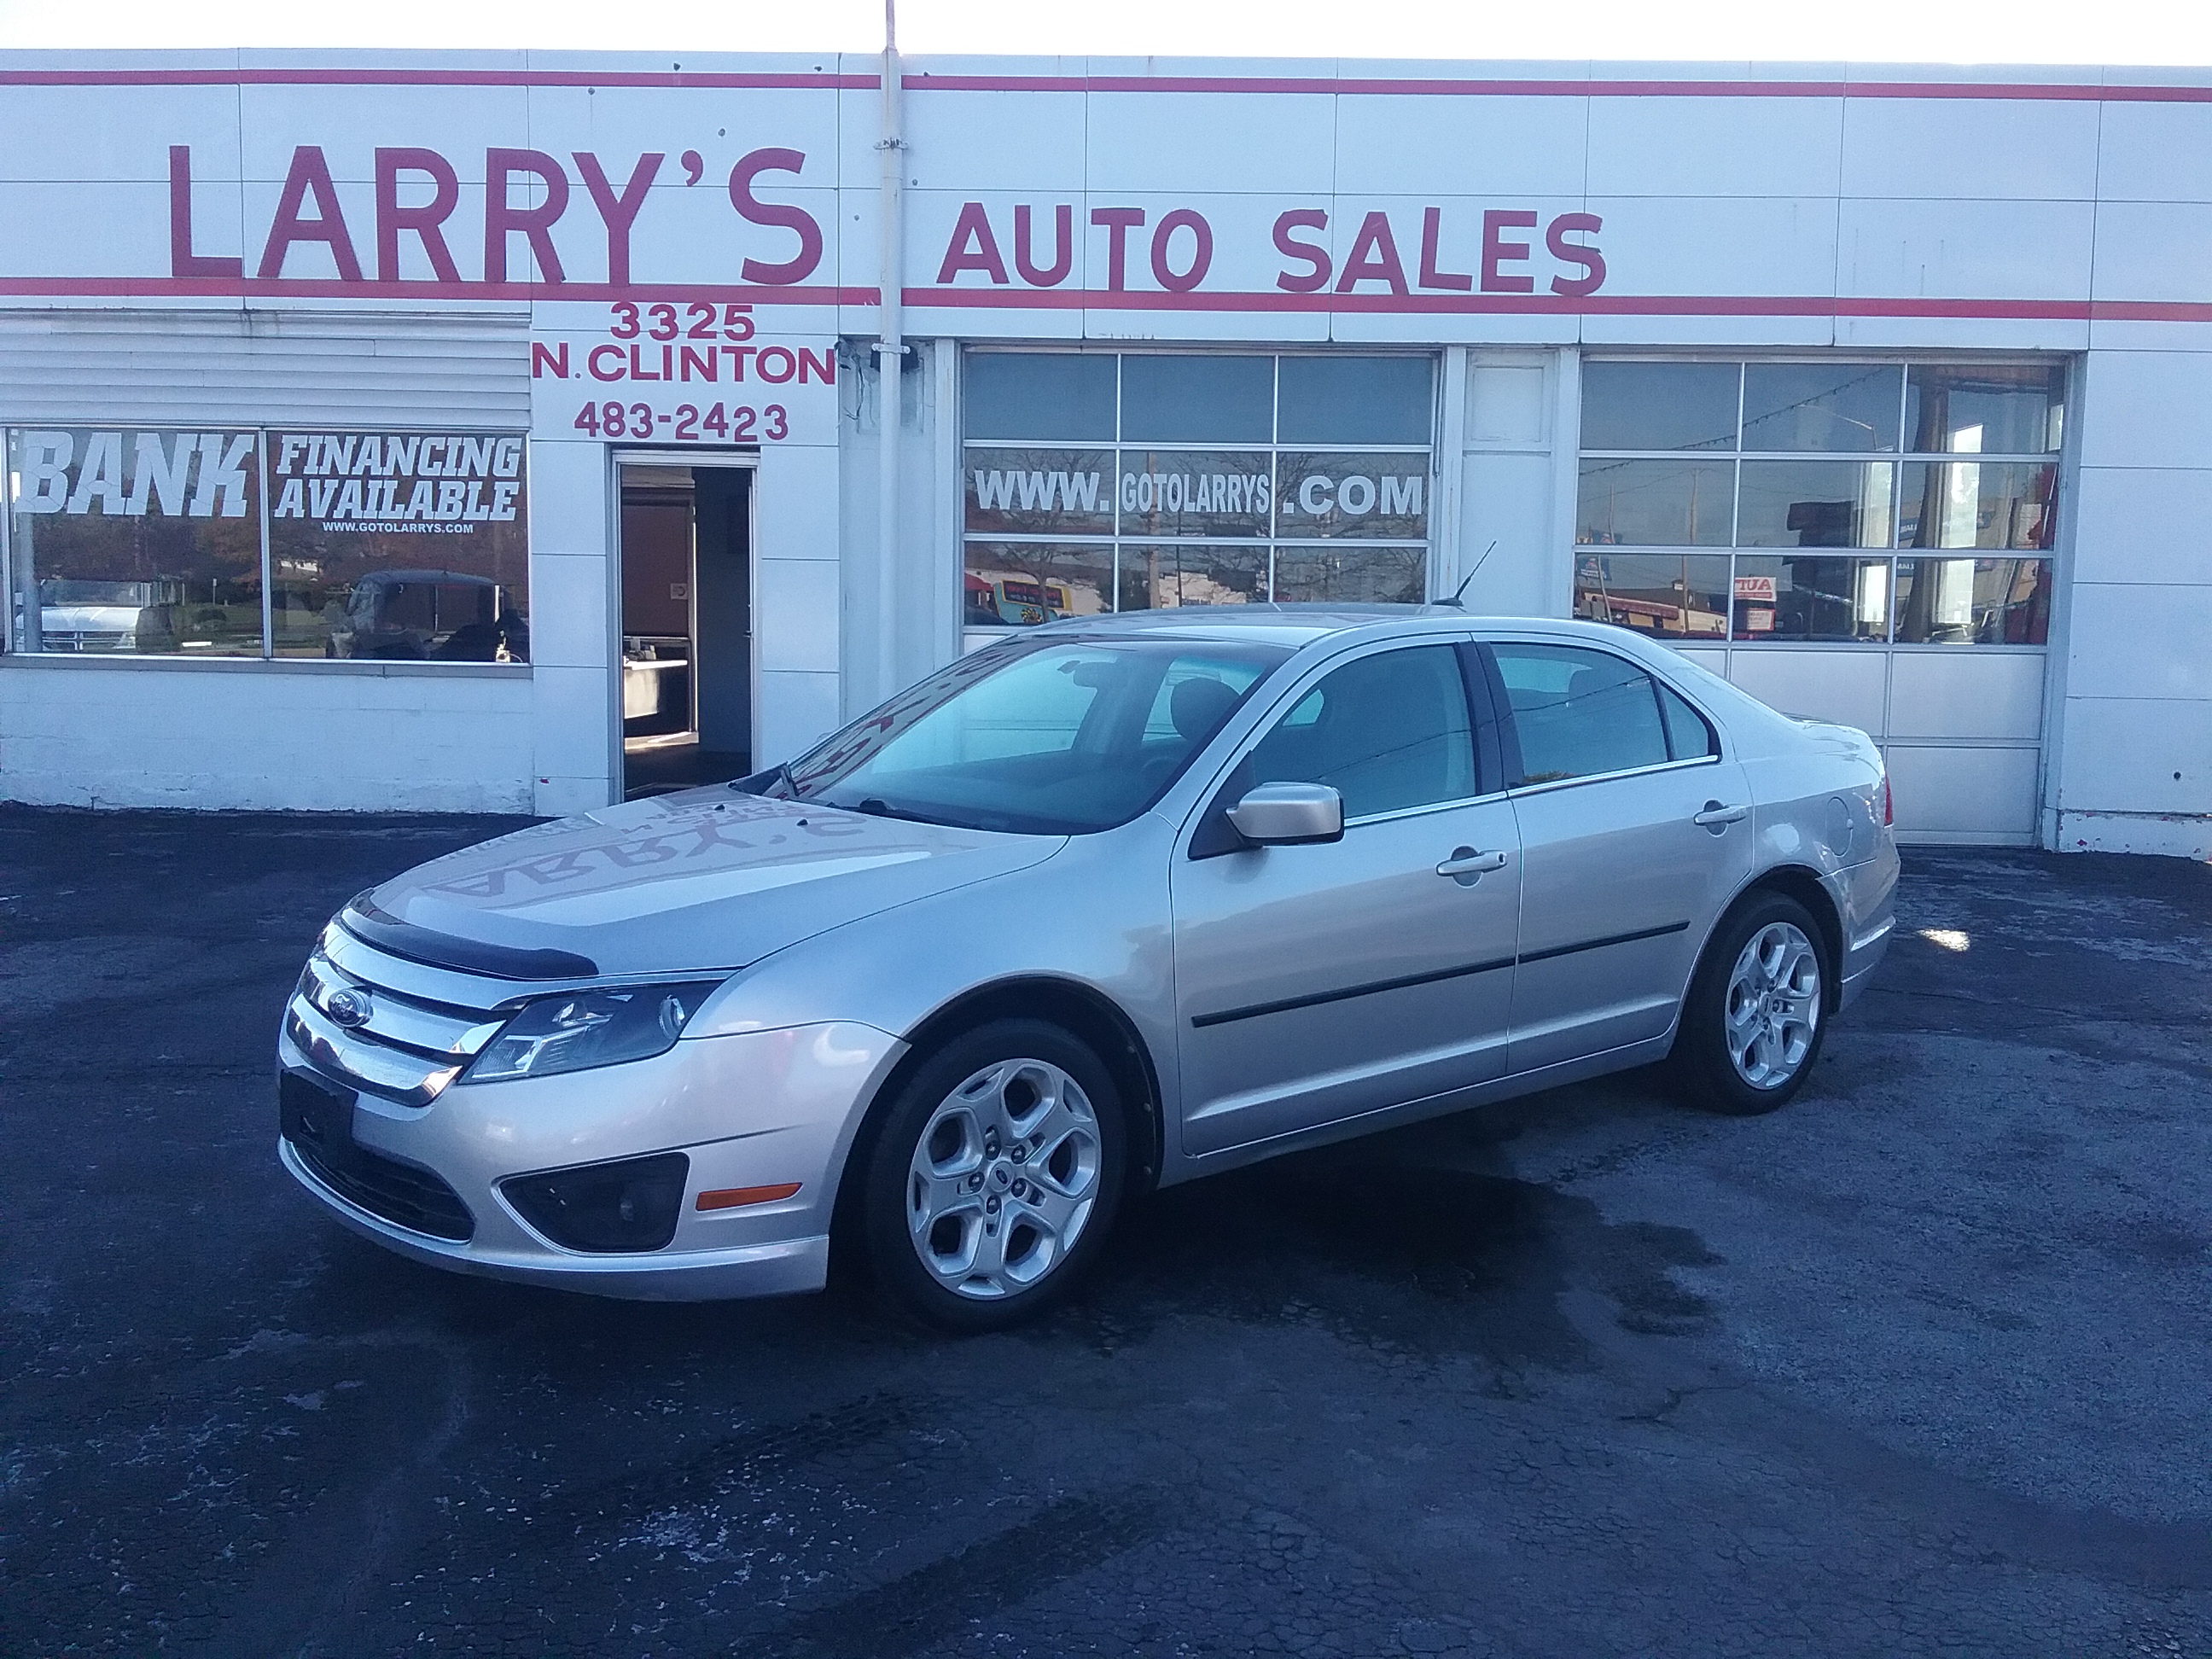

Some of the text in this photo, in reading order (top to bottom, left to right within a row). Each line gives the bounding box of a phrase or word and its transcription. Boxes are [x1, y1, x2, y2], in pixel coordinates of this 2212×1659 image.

[169, 144, 1607, 297] LARRY'S AUTO SALES
[610, 302, 755, 341] 3325
[574, 401, 789, 442] 483-2423
[15, 430, 256, 517] BANK
[276, 434, 524, 478] FINANCING
[274, 479, 521, 521] AVAILABLE
[975, 470, 1423, 515] WWW. GOTOLARRYS .COM
[322, 521, 474, 534] WWW.GOTOLARRYS.COM
